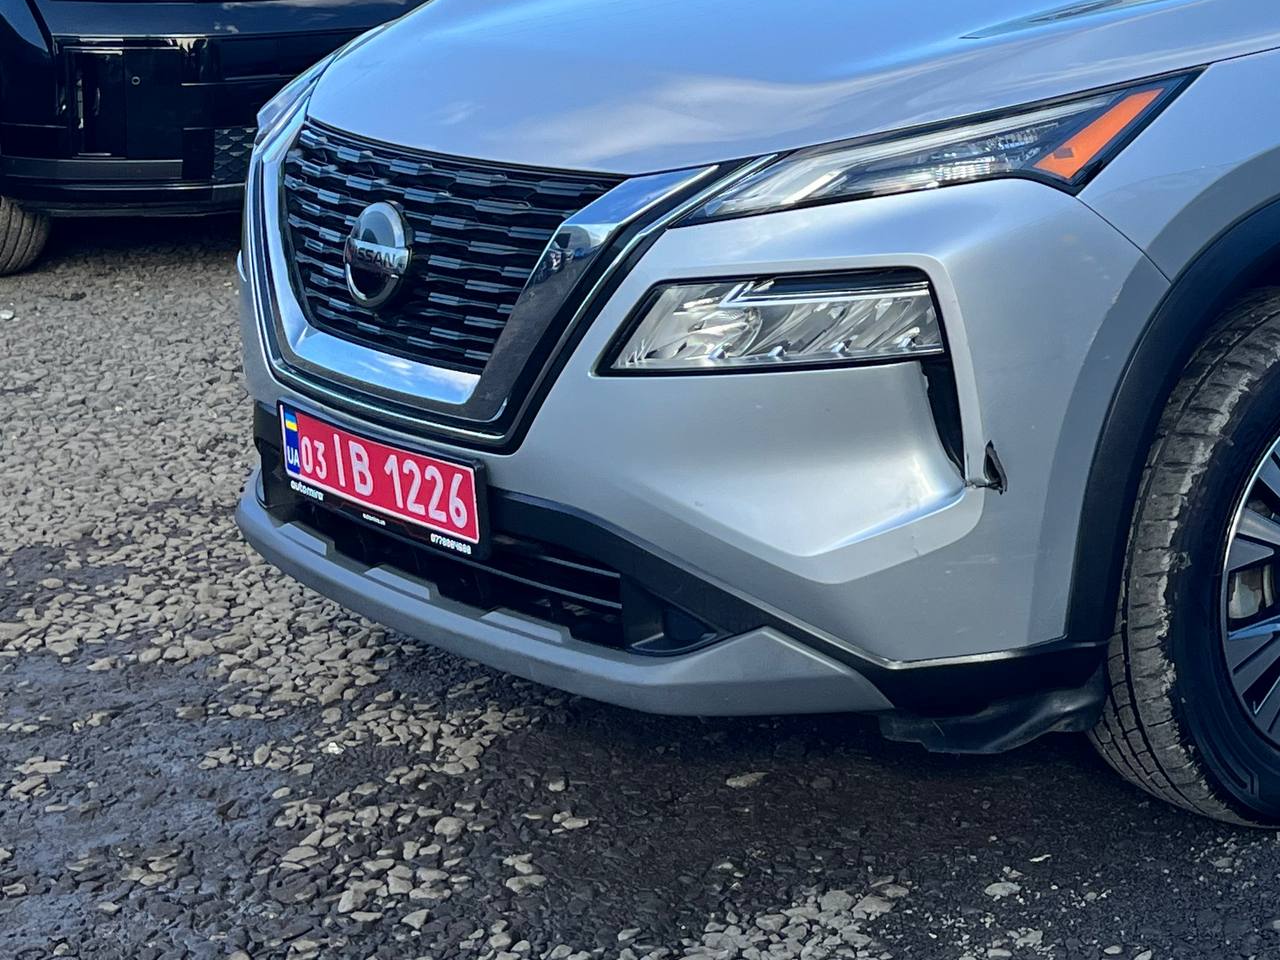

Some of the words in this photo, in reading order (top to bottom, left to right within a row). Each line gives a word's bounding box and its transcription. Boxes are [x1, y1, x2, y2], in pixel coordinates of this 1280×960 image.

[286, 445, 300, 466] UA
[301, 436, 328, 480] 03
[383, 454, 468, 529] 1226
